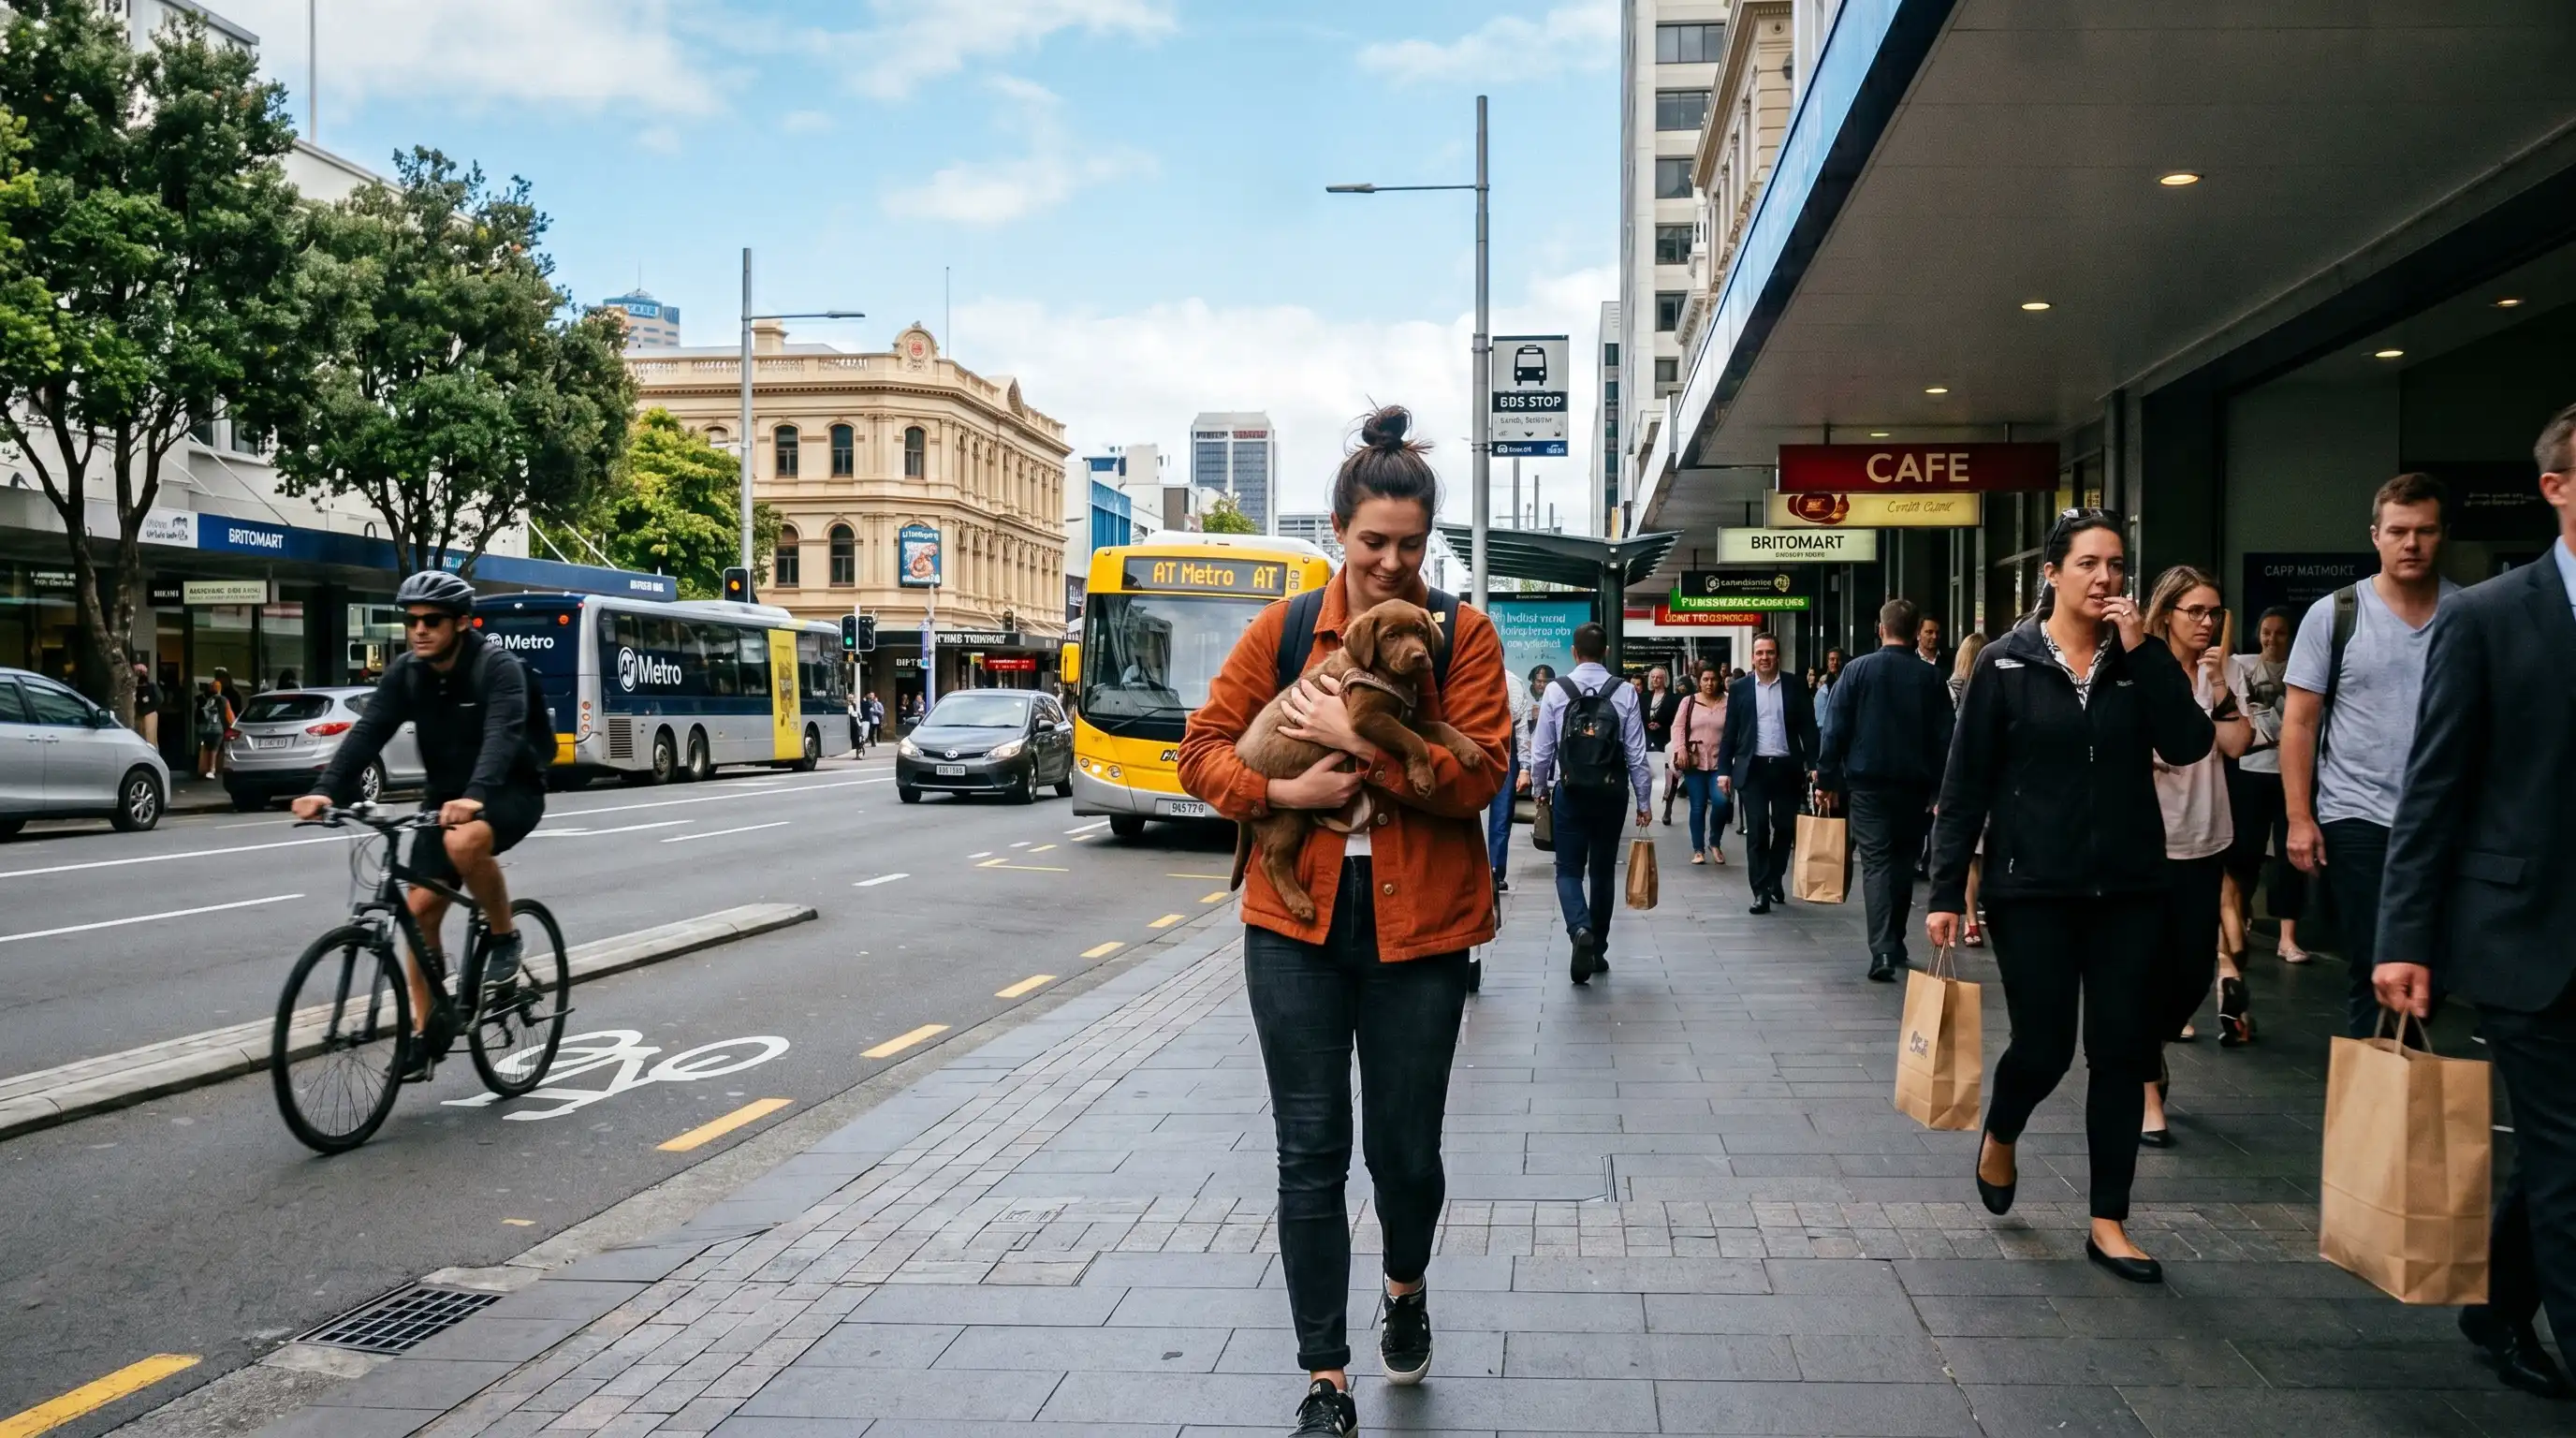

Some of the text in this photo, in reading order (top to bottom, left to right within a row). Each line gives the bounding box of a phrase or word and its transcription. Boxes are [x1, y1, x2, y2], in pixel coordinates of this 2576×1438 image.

[1529, 396, 1561, 407] STOP
[1866, 453, 1969, 483] CAFE
[1751, 536, 1844, 550] BRITOMART
[1153, 562, 1278, 589] AT Metro AT
[505, 635, 554, 650] Metro
[638, 655, 682, 685] Metro
